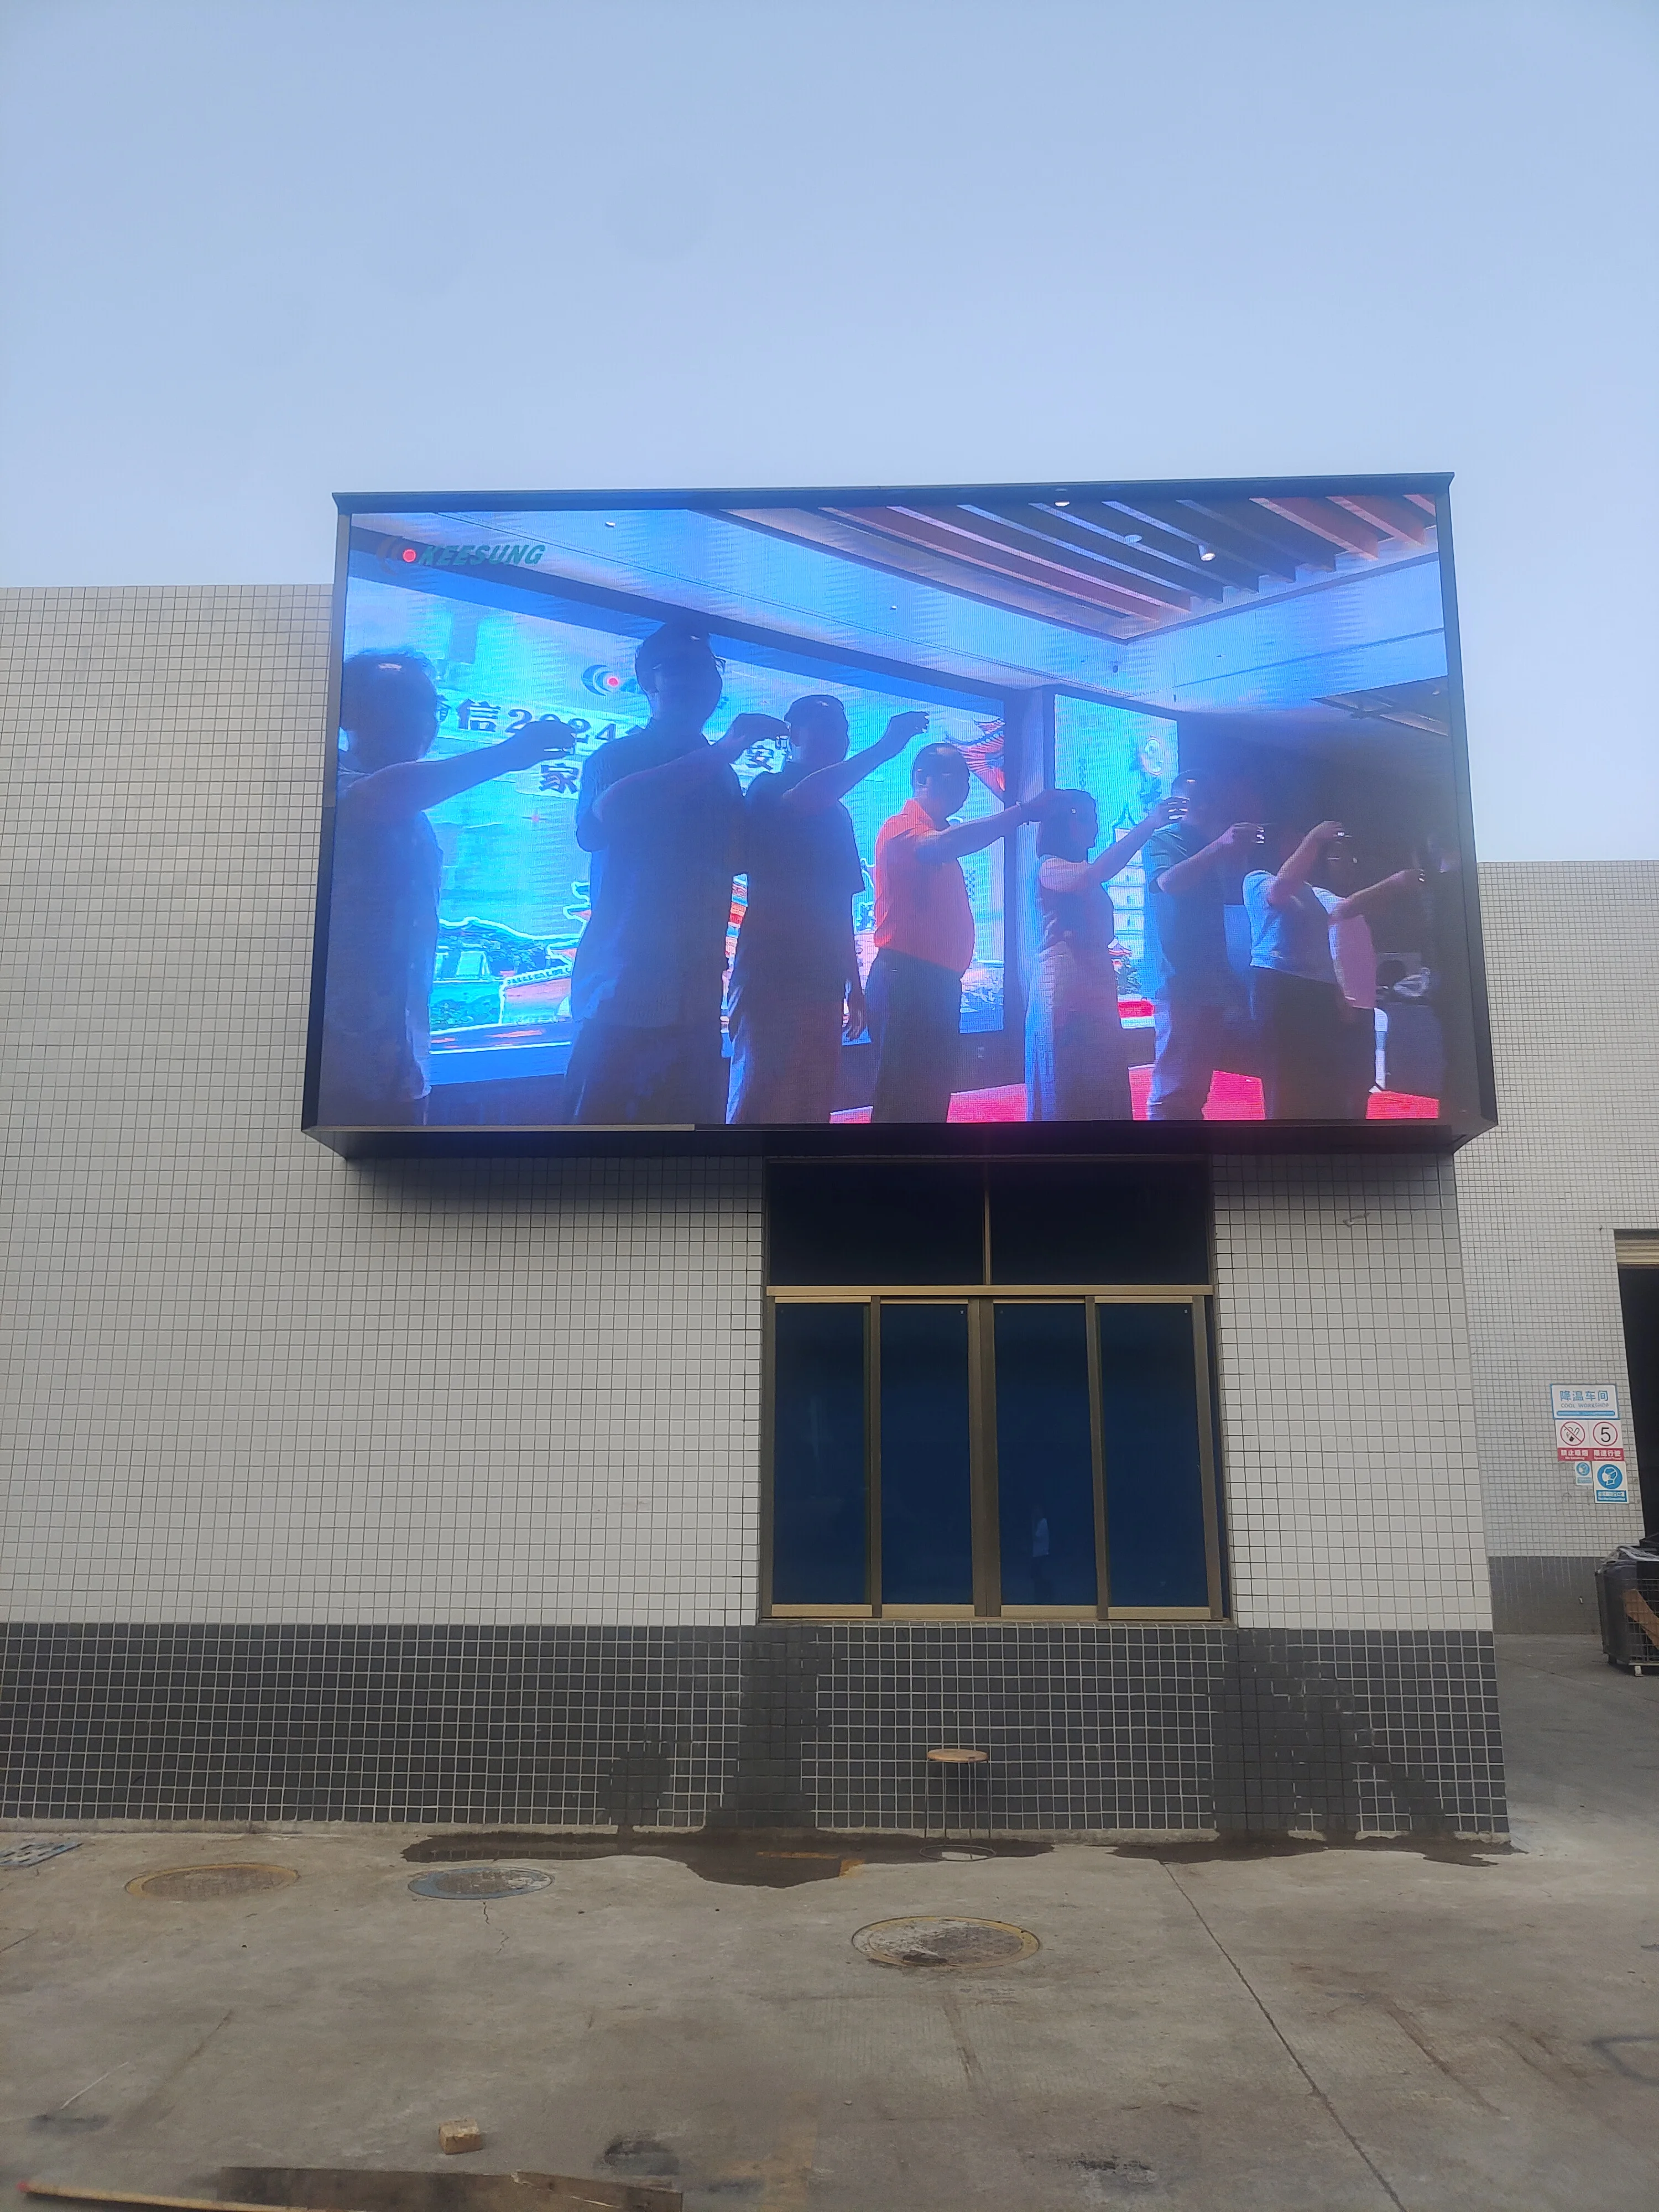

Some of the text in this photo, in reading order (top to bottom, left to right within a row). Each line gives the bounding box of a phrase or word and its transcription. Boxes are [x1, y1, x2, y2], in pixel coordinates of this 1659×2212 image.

[418, 545, 545, 565] KEESUNG
[1559, 1390, 1609, 1401] 降温车间
[1600, 1427, 1611, 1443] 5
